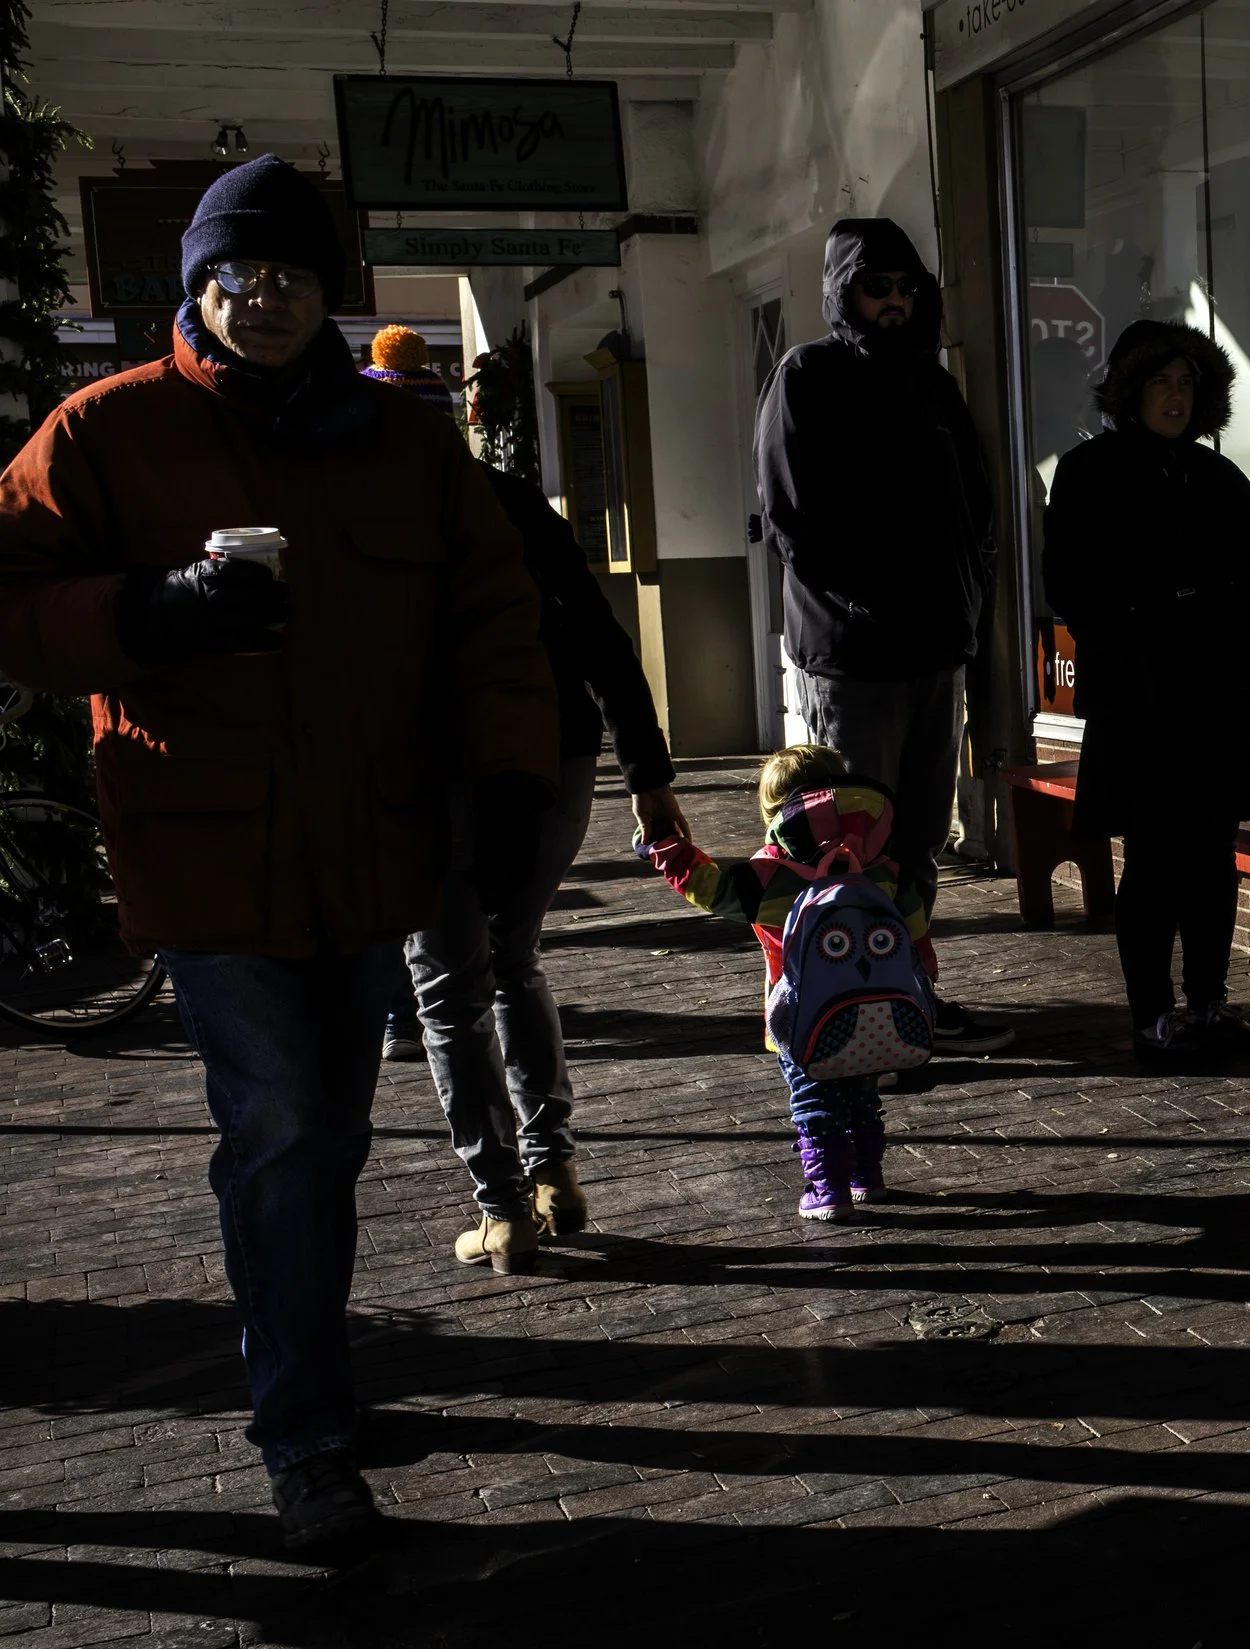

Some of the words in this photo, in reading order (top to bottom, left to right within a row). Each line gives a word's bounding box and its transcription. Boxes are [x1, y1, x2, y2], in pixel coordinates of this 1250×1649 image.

[381, 87, 565, 184] Mimosa
[420, 179, 448, 192] The
[451, 179, 486, 192] Santa
[489, 178, 504, 192] Fe
[507, 179, 561, 194] Clothing
[563, 181, 597, 193] Store
[405, 237, 483, 260] Simply
[491, 238, 550, 256] Santa
[557, 238, 581, 256] Fe
